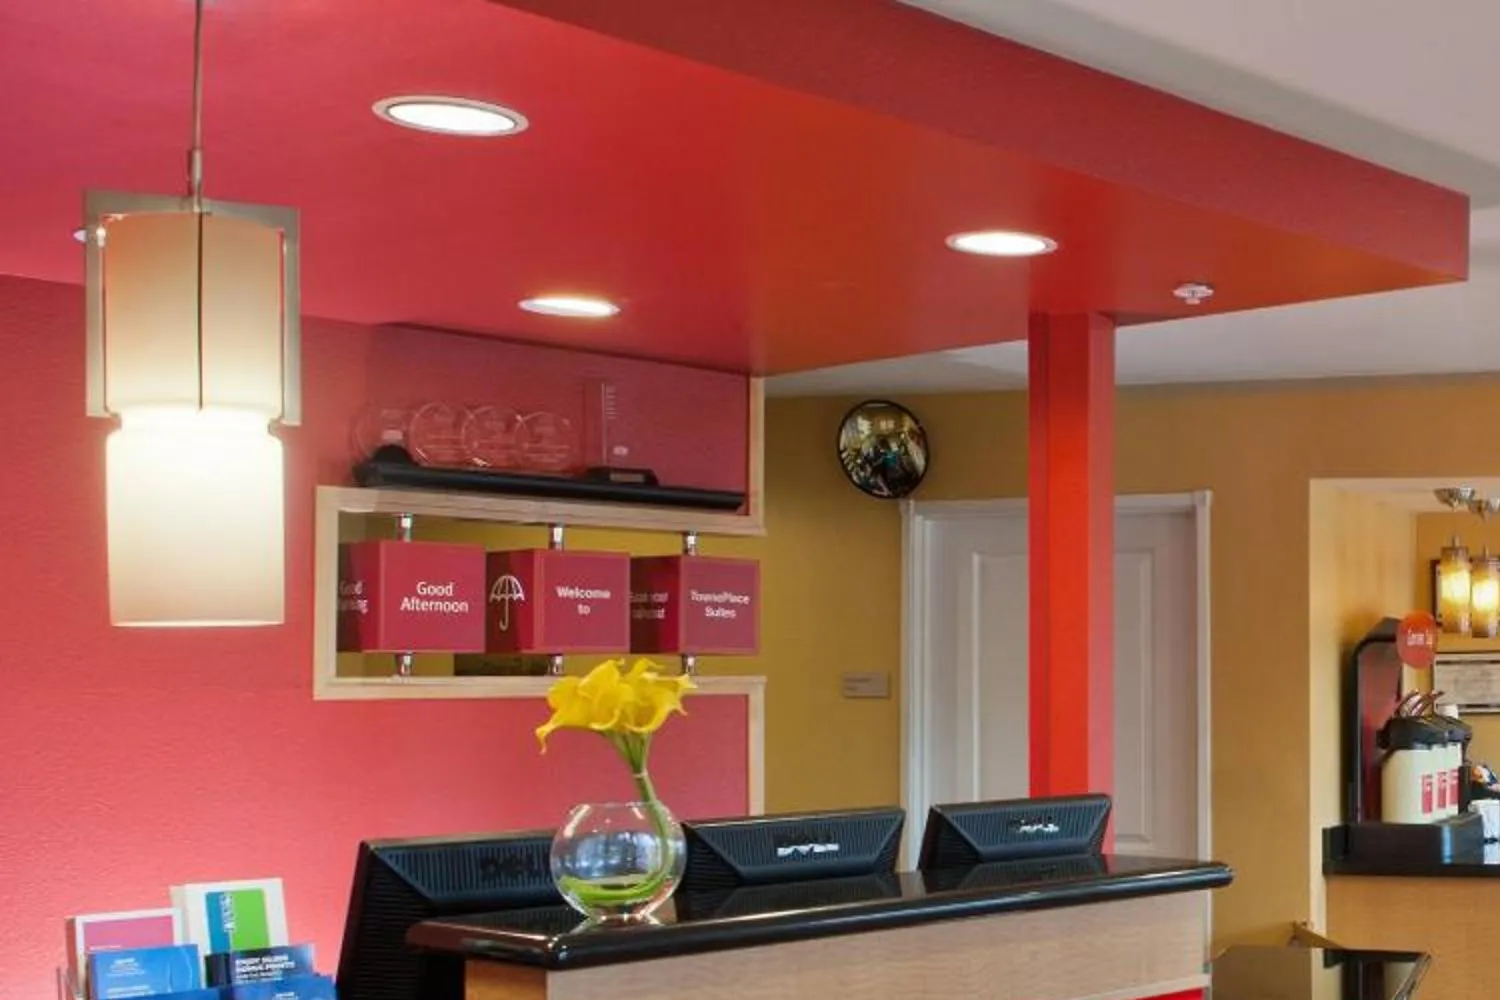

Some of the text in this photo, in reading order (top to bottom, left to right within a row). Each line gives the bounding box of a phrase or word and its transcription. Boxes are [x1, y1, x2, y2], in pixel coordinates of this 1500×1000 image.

[416, 581, 455, 597] Good
[556, 585, 611, 600] Welcome
[399, 596, 470, 614] Afternoon
[577, 603, 591, 616] to
[704, 605, 737, 618] Suites
